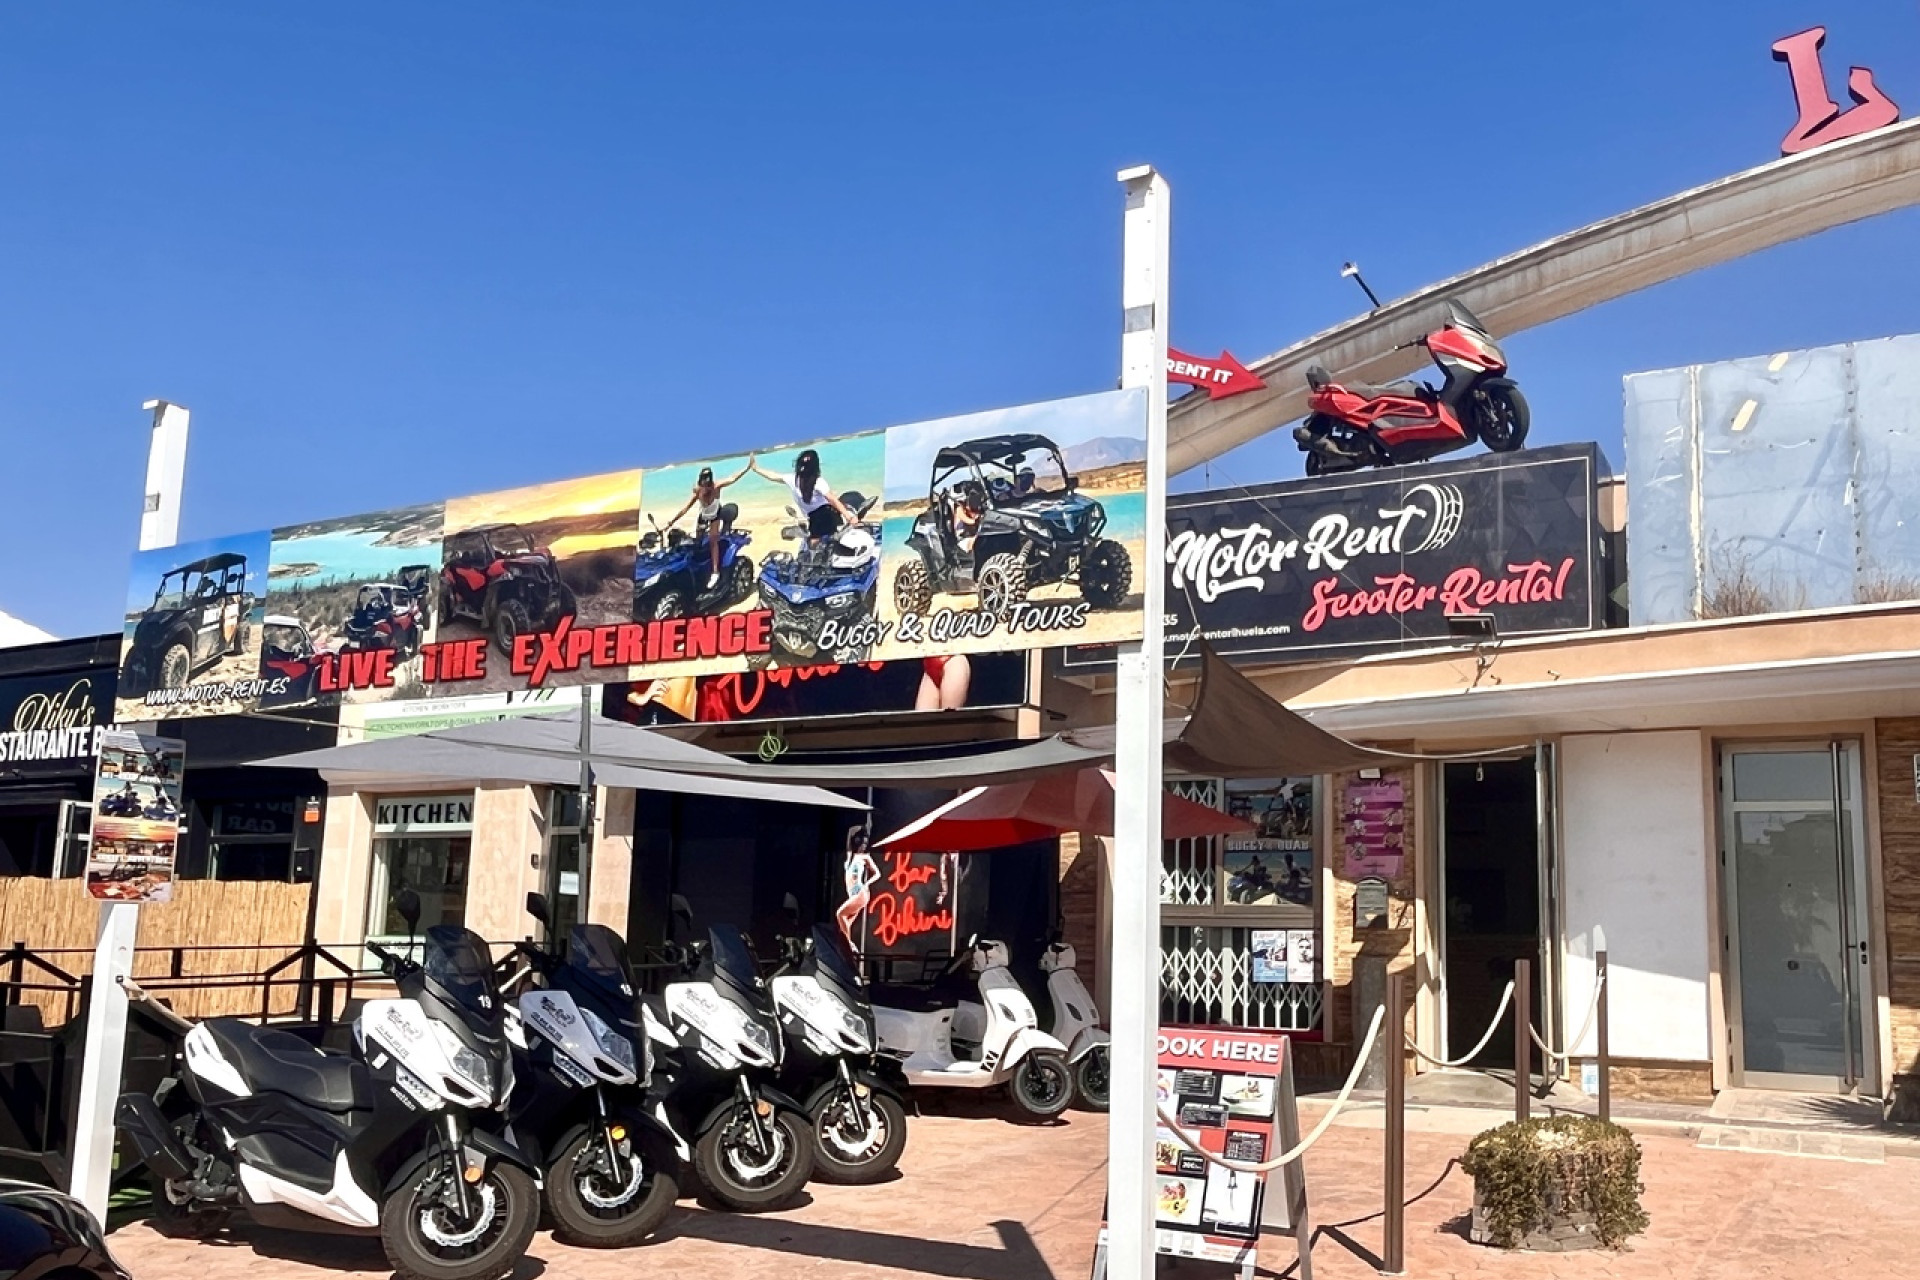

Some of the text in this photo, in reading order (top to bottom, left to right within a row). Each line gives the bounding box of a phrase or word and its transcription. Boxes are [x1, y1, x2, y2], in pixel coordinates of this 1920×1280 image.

[1167, 358, 1234, 385] RENT IT
[1166, 504, 1428, 604] Motor Rent
[1301, 557, 1575, 632] Scooter Rental
[318, 648, 395, 692] LIVE
[420, 638, 487, 683] THE
[511, 608, 774, 687] EXPERIENCE
[817, 601, 1092, 650] BUGGY & QUAD TOURS
[377, 801, 472, 825] KITCHEN
[1157, 1034, 1281, 1064] OOK HERE
